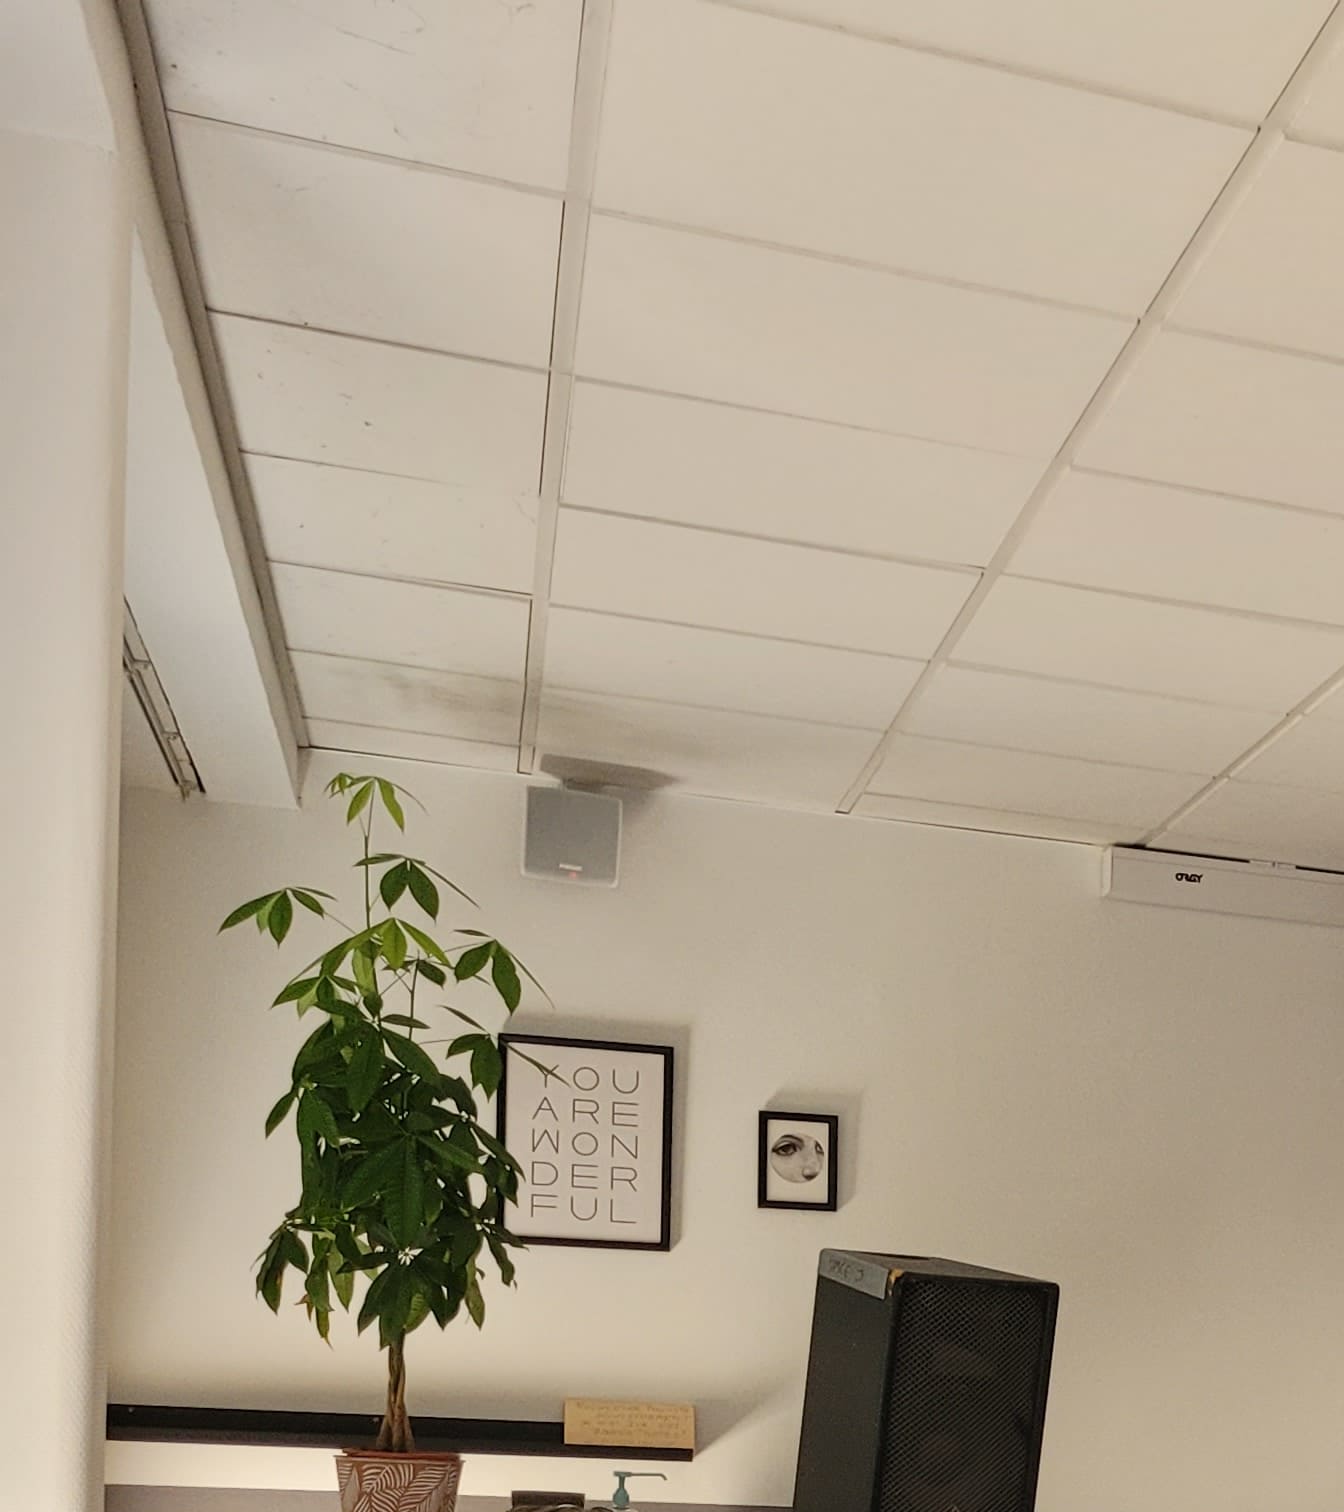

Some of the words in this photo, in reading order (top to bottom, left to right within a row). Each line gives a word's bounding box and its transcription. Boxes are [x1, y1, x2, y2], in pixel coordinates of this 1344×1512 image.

[538, 1064, 639, 1094] YOU
[532, 1097, 639, 1127] ARE
[532, 1129, 638, 1159] WON
[532, 1161, 638, 1192] DER
[531, 1194, 637, 1224] FUL
